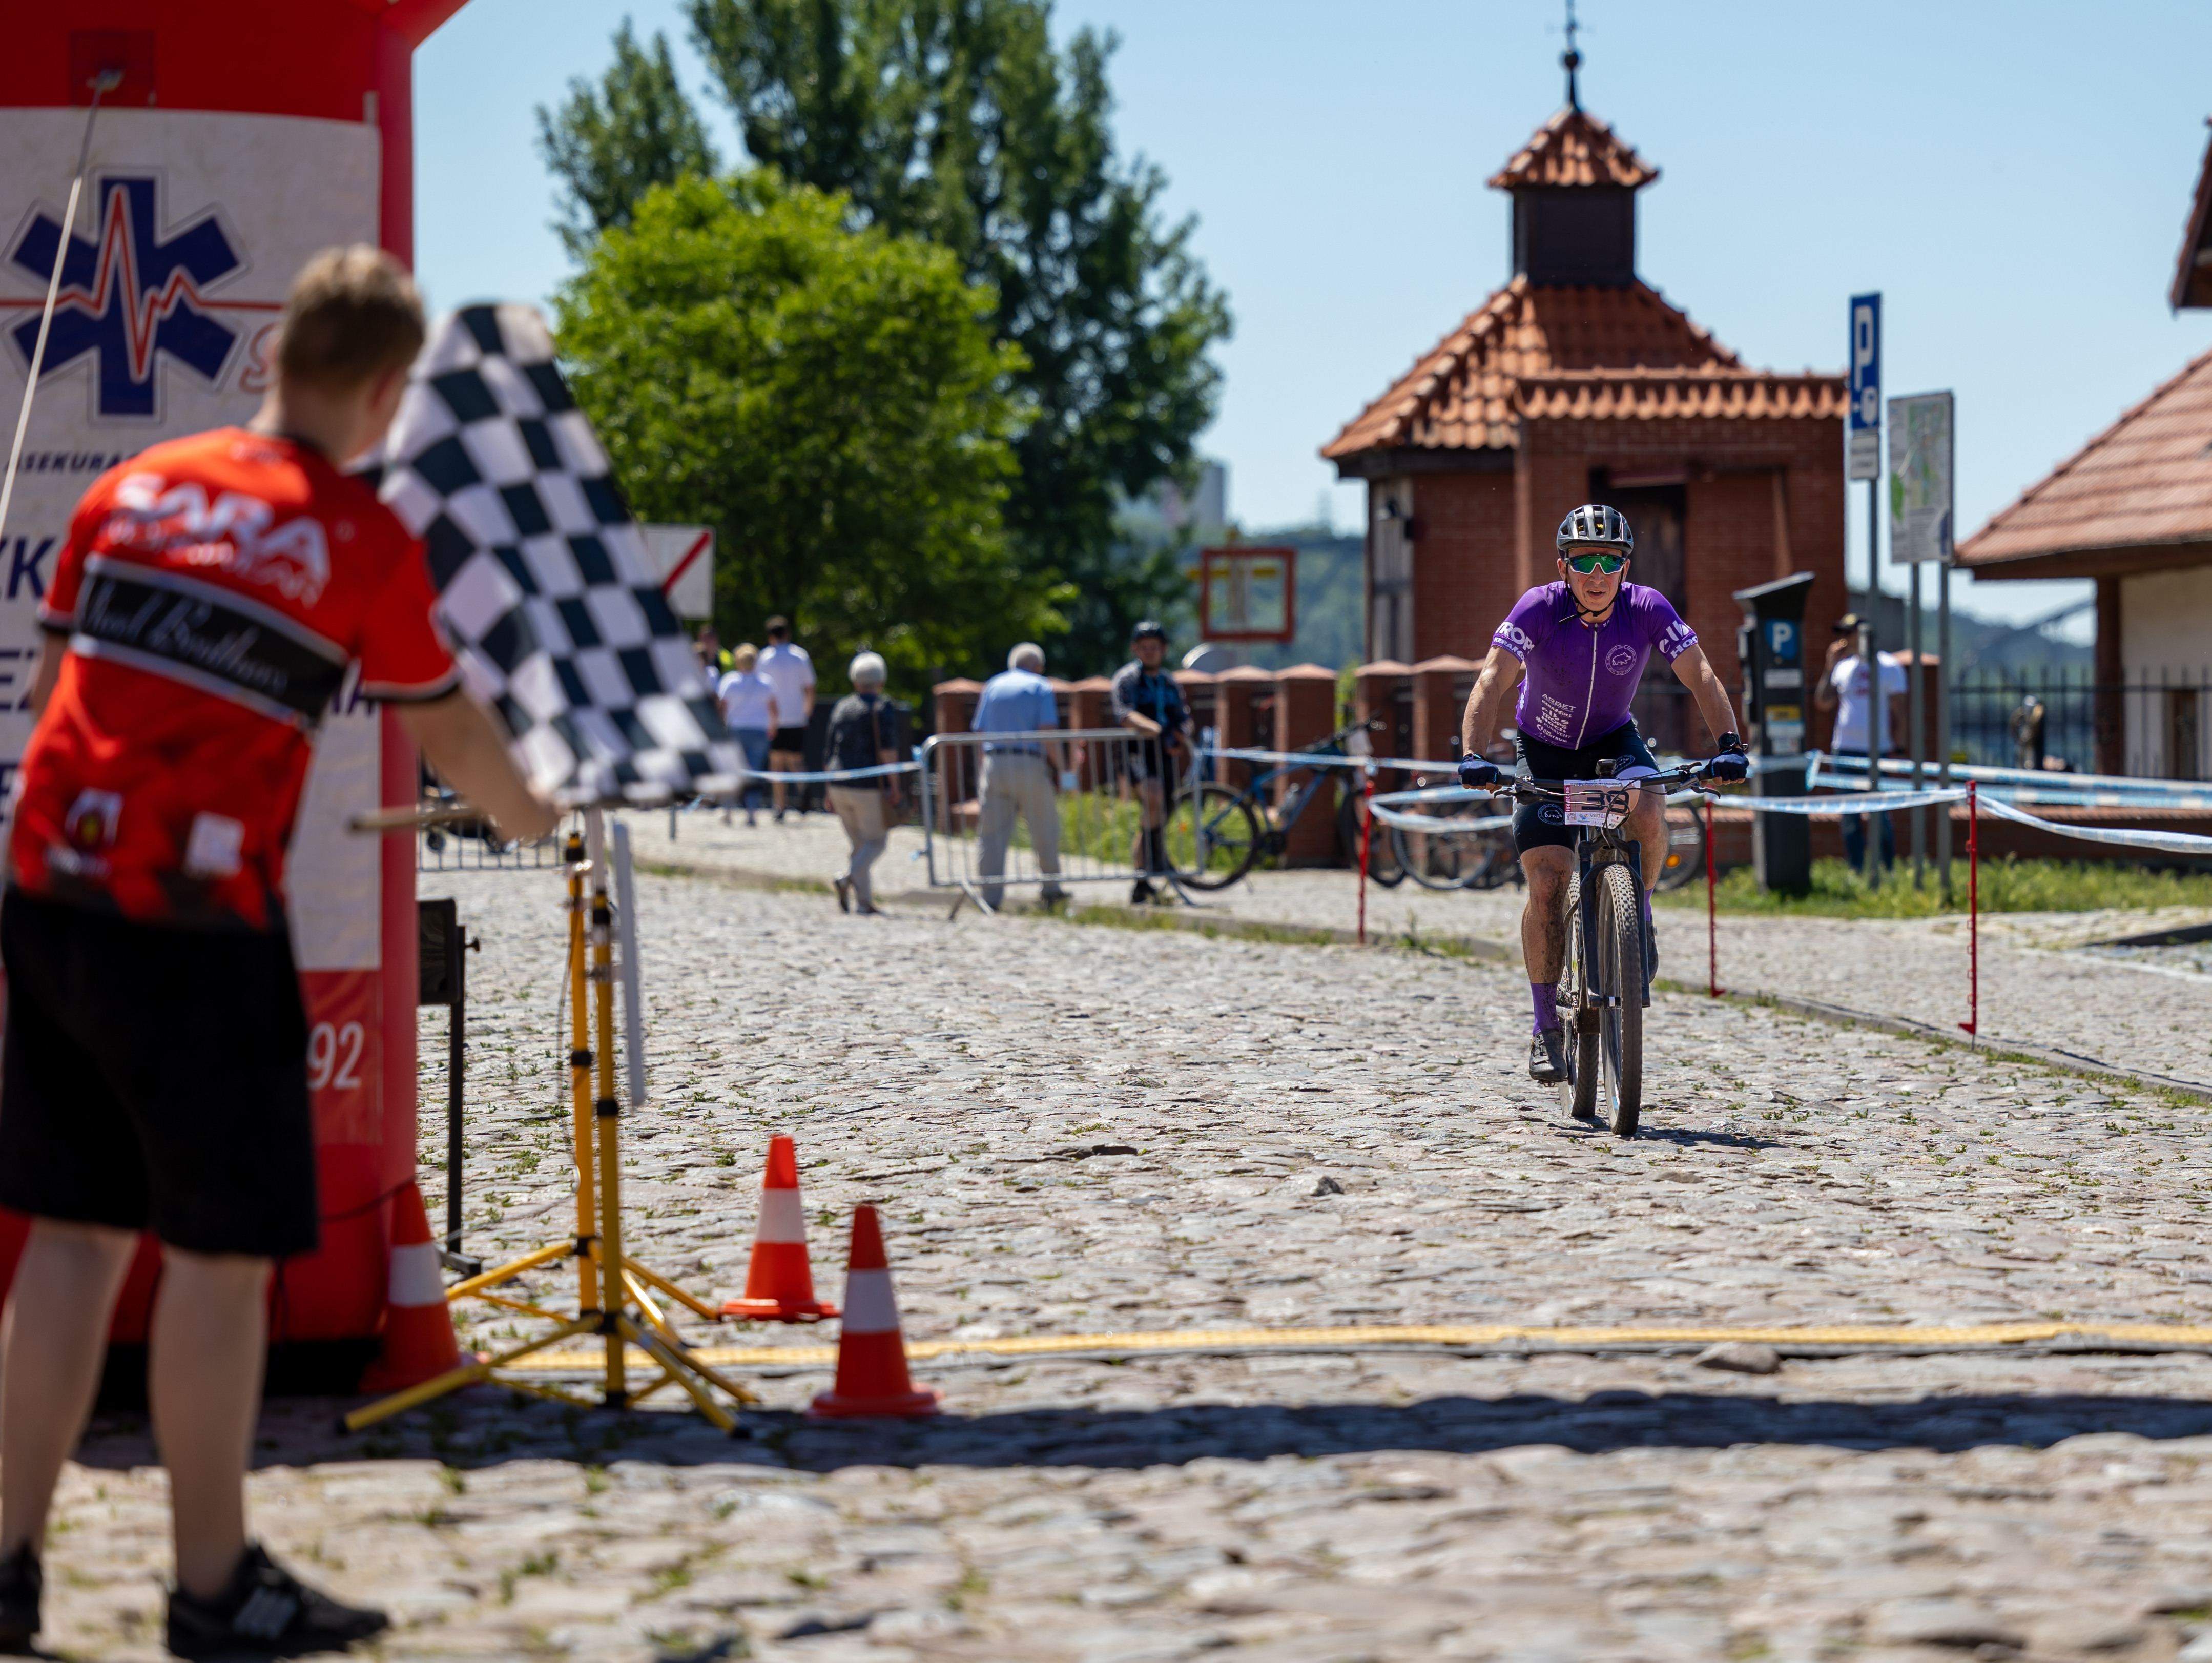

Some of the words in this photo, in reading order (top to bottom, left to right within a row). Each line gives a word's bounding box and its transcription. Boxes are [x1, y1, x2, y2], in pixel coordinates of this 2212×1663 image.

[1772, 622, 1793, 654] P
[1542, 693, 1576, 711] ARBET
[1542, 711, 1567, 729] TROPS
[1543, 722, 1572, 738] PURAVENT
[1581, 790, 1629, 813] 39
